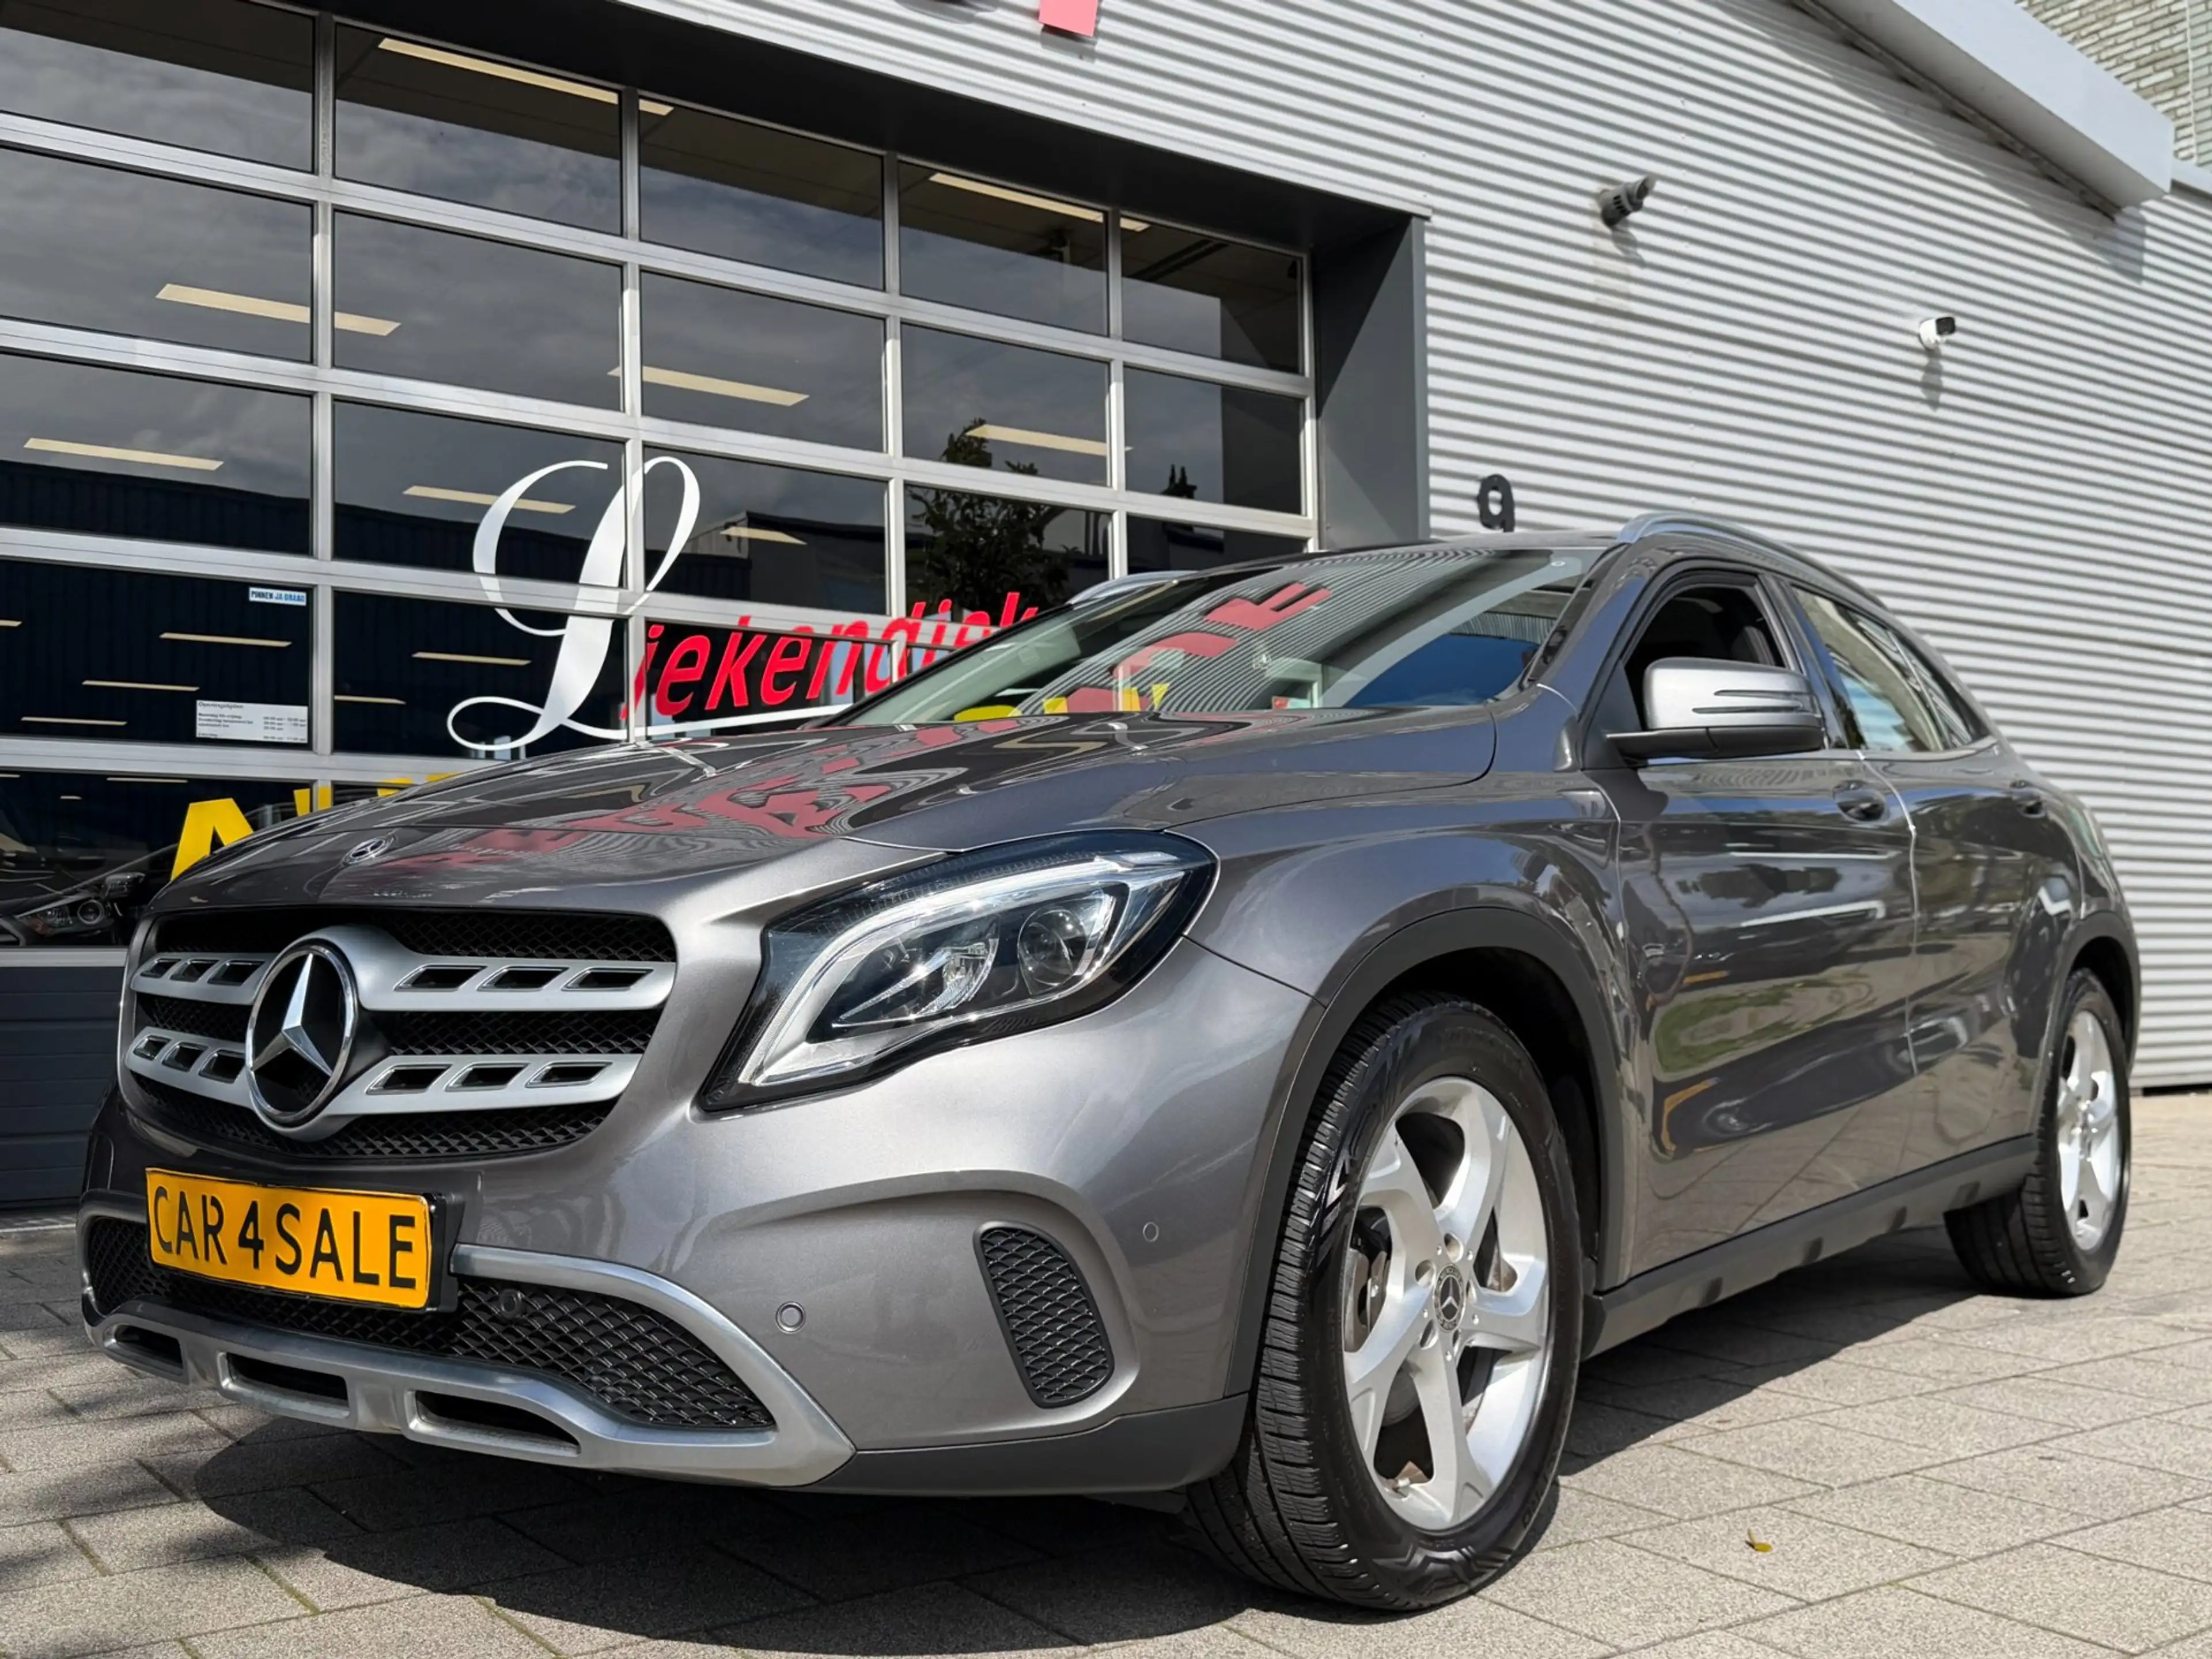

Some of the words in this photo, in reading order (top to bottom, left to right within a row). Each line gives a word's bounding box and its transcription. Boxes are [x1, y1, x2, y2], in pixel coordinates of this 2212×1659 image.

[1477, 474, 1515, 532] 9
[153, 1185, 227, 1265] CAR
[238, 1200, 264, 1270] 4
[275, 1202, 417, 1289] SALE
